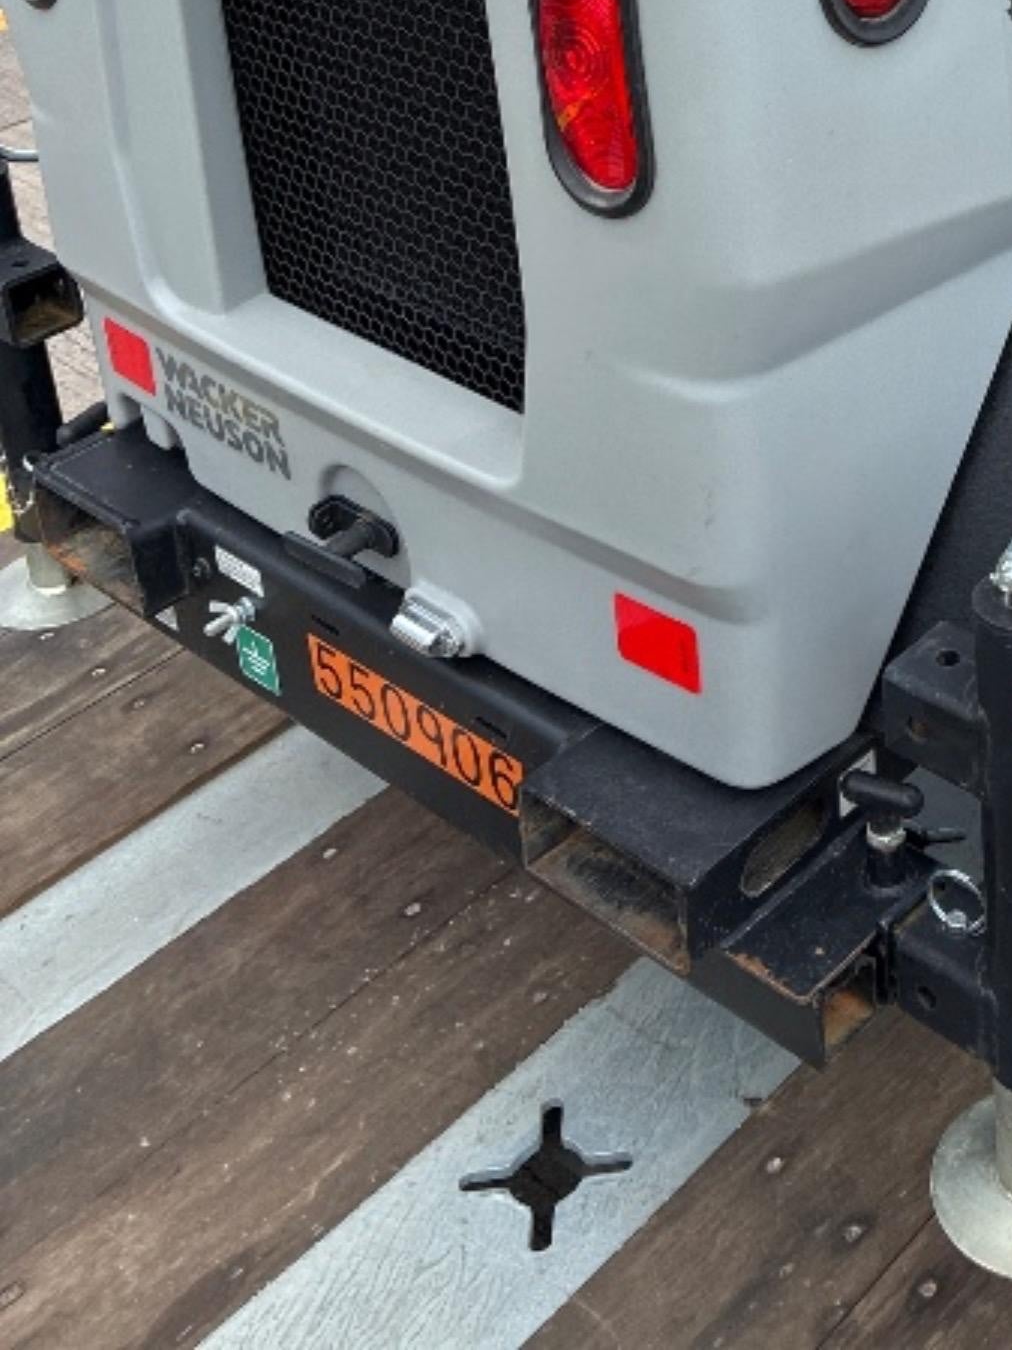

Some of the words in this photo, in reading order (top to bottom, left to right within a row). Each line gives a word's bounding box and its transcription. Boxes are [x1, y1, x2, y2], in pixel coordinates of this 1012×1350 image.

[156, 347, 286, 448] WACKER
[164, 382, 292, 481] NEUSON
[316, 640, 520, 810] 550906
